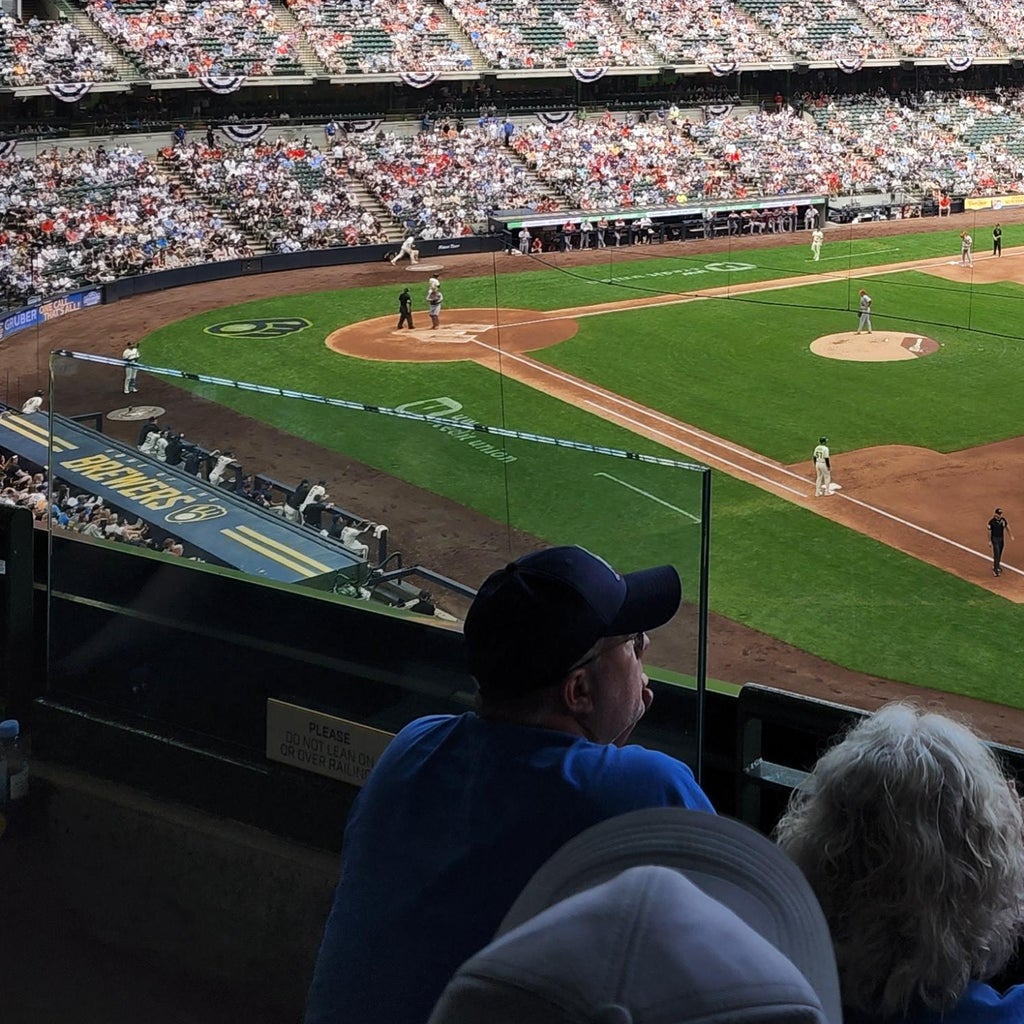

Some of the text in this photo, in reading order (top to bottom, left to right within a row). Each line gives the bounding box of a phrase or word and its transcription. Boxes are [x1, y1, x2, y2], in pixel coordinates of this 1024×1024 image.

[39, 298, 68, 314] ONE CALL
[44, 302, 80, 321] THAT'S ALL!
[4, 309, 37, 330] GRUBER
[468, 438, 517, 464] union
[59, 454, 197, 511] BREWERS
[309, 721, 350, 745] PLEASE
[280, 743, 295, 758] OR
[298, 748, 326, 767] OVER
[285, 731, 375, 767] DO NOT LEAN ON
